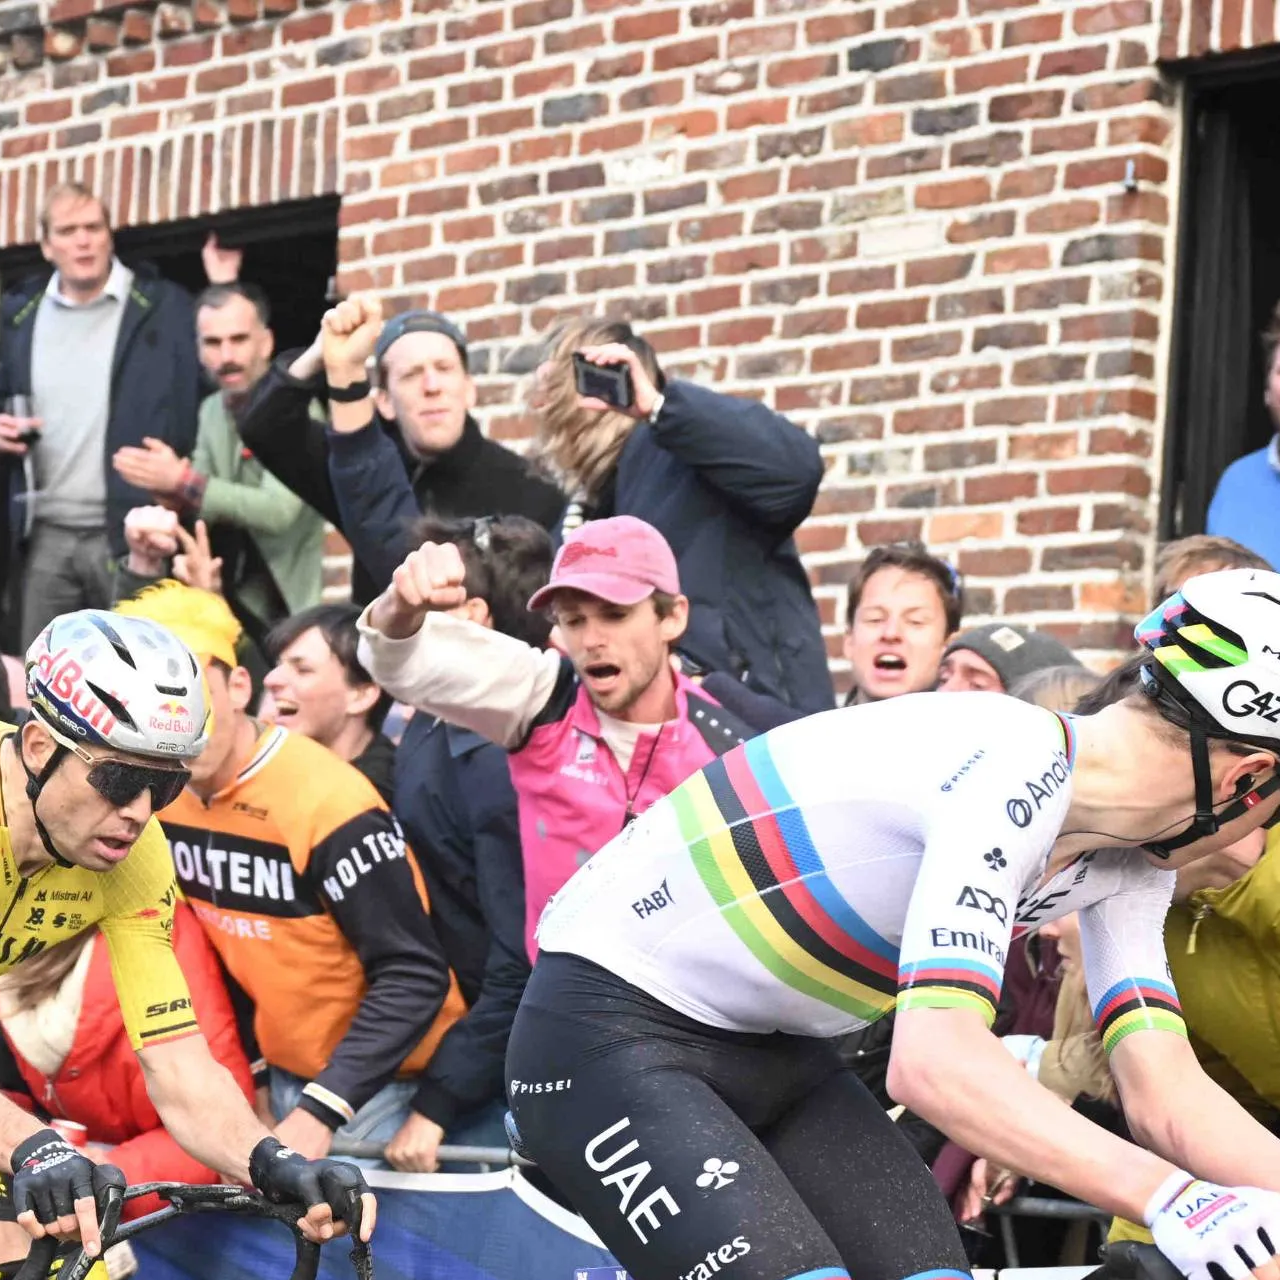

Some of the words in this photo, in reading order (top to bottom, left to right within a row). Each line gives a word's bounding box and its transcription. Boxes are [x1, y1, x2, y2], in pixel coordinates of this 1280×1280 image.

[149, 715, 172, 732] Red
[172, 719, 193, 733] Bull
[156, 742, 186, 752] GIRO
[167, 839, 296, 901] OLTENI
[50, 890, 79, 901] Mistral
[931, 927, 1005, 966] Emira
[521, 1078, 571, 1094] PISSEI
[585, 1116, 681, 1245] UAE
